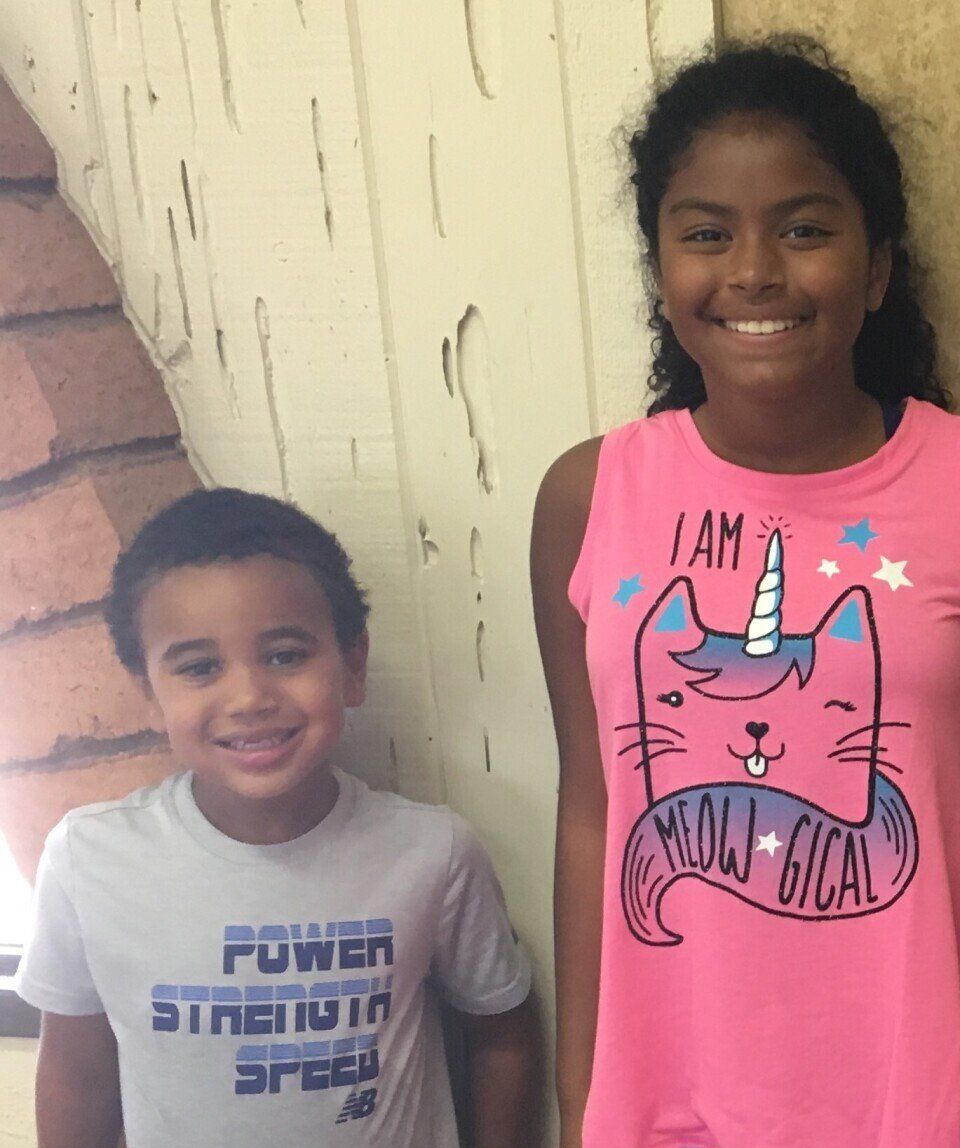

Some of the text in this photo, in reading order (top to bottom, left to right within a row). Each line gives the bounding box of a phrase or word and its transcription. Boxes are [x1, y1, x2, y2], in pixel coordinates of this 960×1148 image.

[670, 509, 744, 571] I AM
[654, 793, 879, 911] MEOW GICAL
[222, 918, 394, 975] POWER
[151, 975, 394, 1036] STRENGTH
[234, 1033, 380, 1095] SPEED
